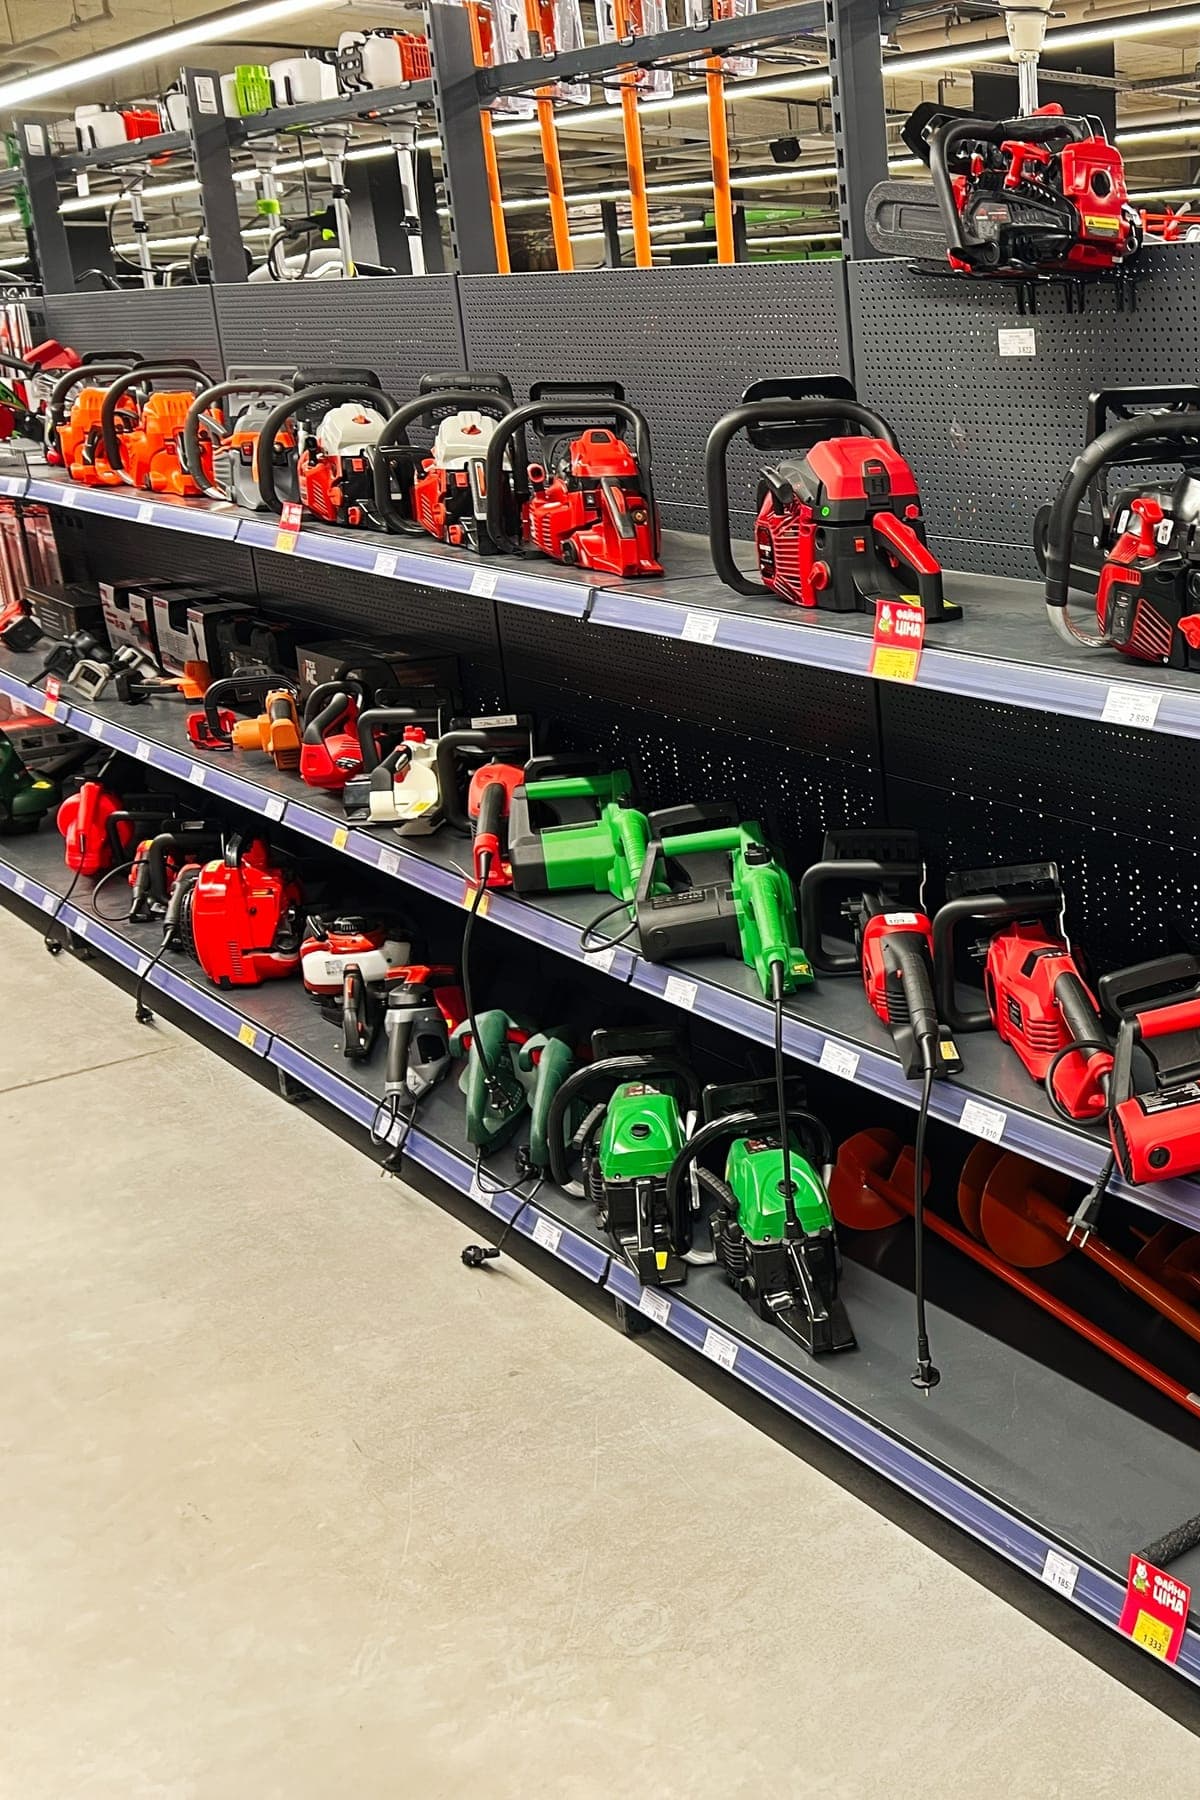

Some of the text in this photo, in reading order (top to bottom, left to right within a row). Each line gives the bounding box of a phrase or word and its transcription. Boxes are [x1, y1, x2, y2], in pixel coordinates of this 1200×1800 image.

[895, 620, 921, 638] ЦІНА
[1129, 713, 1149, 723] 2 899
[1058, 1576, 1069, 1589] 185
[1154, 1575, 1187, 1602] ФАЙНА
[1152, 1585, 1184, 1616] ЦІНА
[1148, 1638, 1162, 1651] 333
